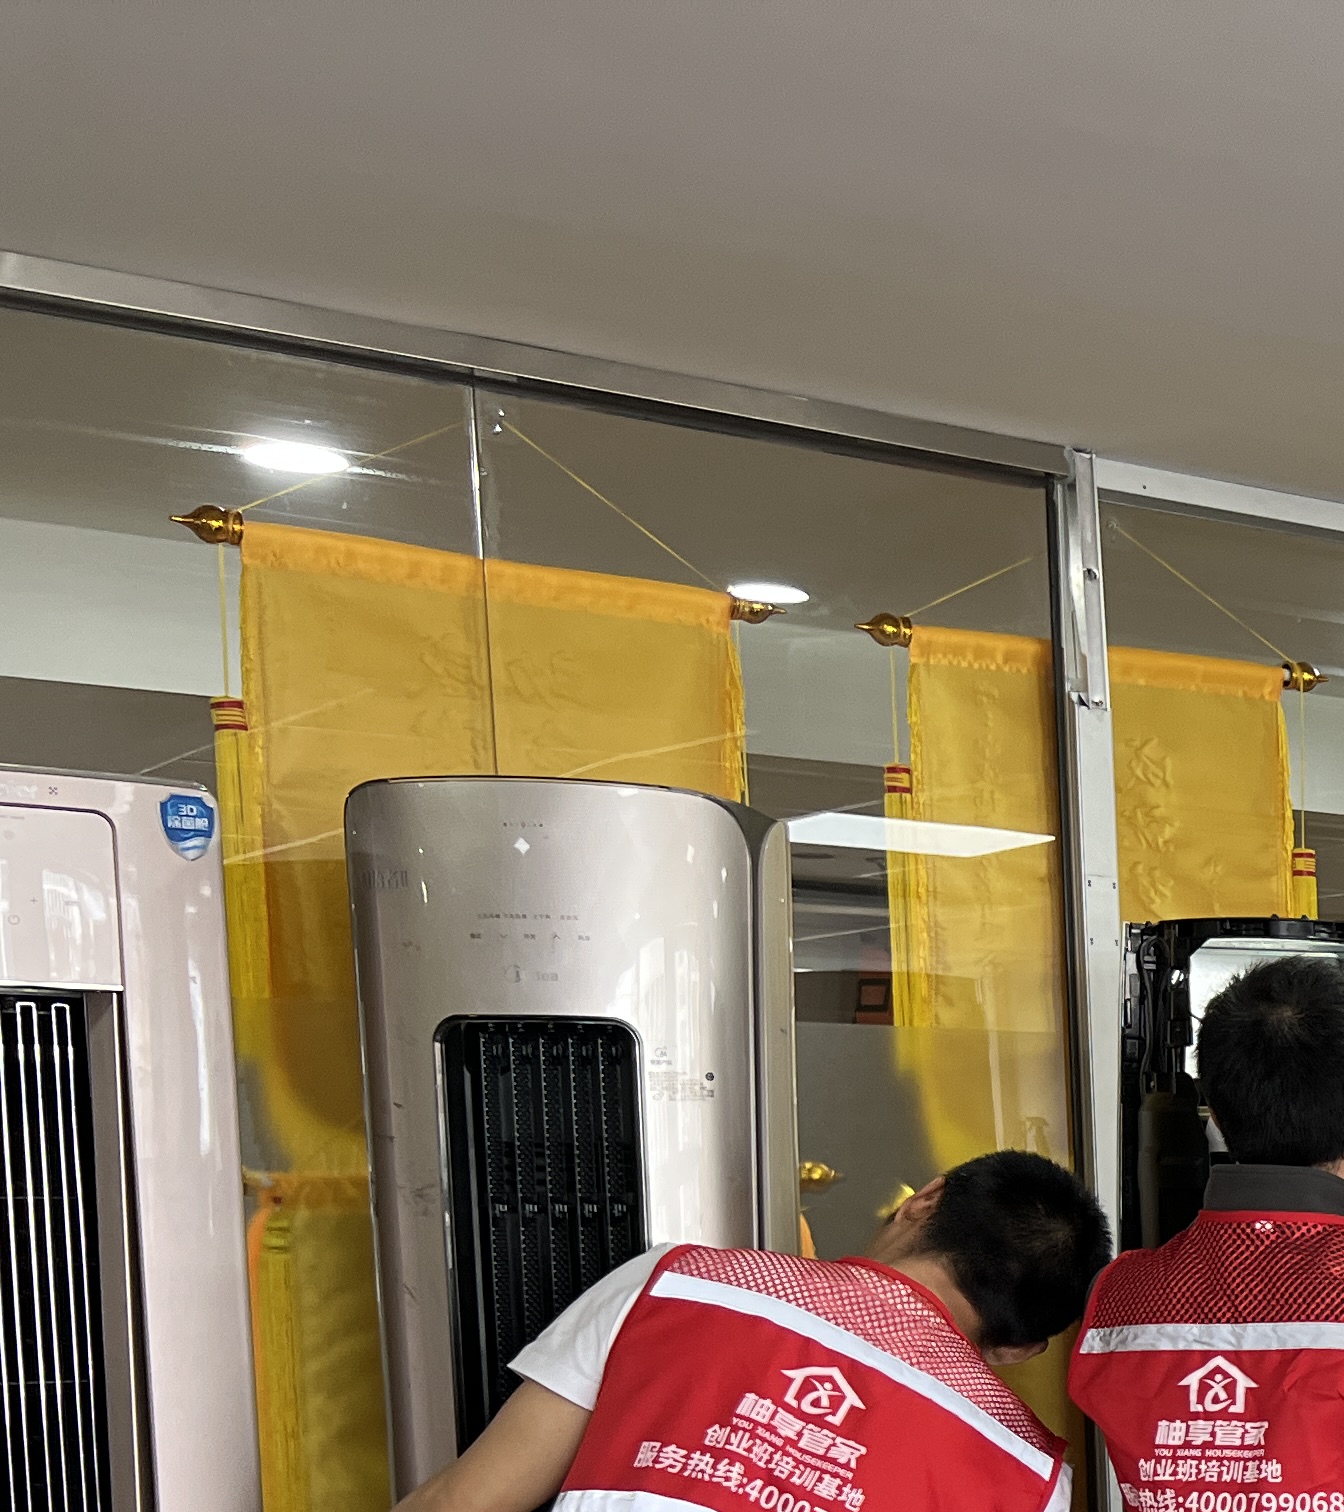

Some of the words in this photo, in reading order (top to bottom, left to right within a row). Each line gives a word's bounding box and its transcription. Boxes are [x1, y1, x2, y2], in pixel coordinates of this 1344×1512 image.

[178, 804, 197, 816] 3D
[732, 1416, 754, 1431] YOU
[755, 1425, 785, 1448] XIANG
[735, 1392, 867, 1469] 柚享管家
[1154, 1419, 1270, 1447] 柚享管家
[1154, 1448, 1173, 1457] YOU
[1175, 1448, 1202, 1457] XIANG
[703, 1423, 866, 1512] 创业班培训基地
[1138, 1458, 1283, 1483] 创业班培训基地
